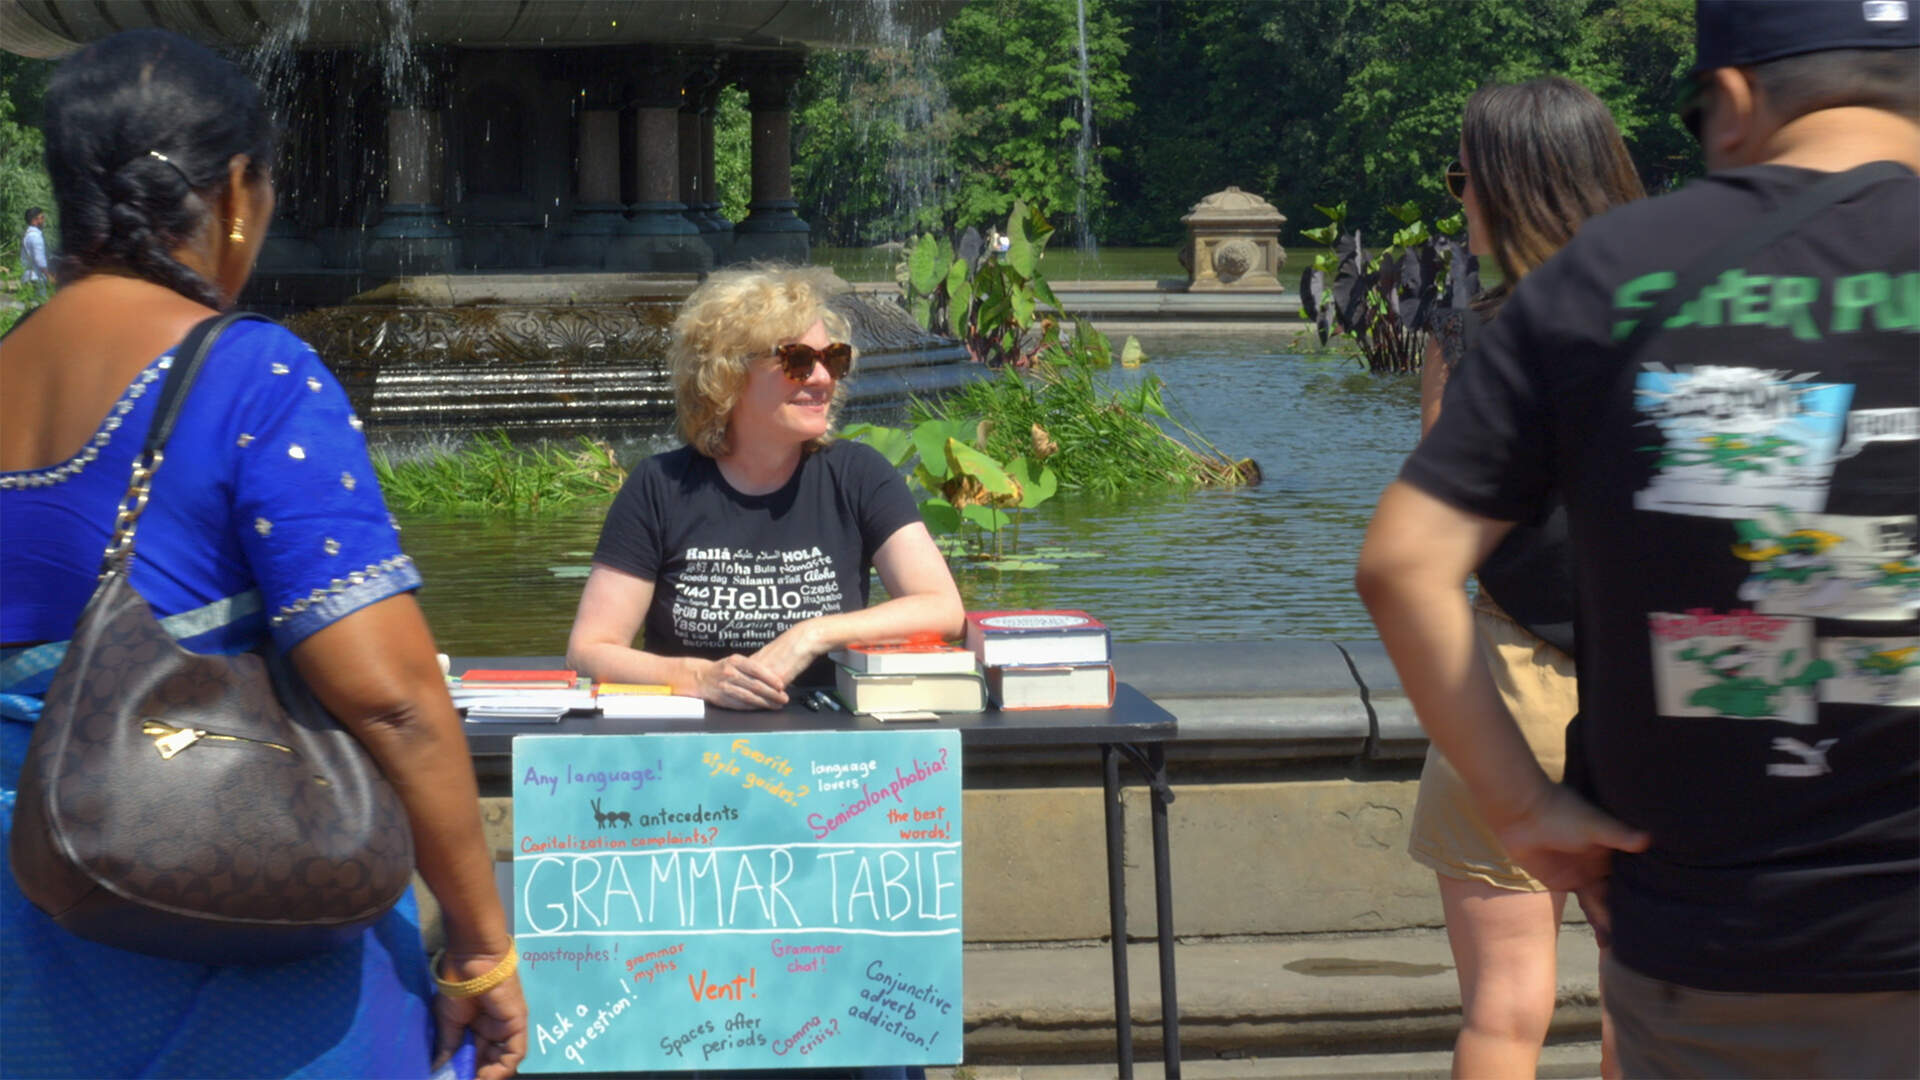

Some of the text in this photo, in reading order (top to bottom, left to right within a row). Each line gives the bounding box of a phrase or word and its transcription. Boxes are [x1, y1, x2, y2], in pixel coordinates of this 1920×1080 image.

[1609, 268, 1823, 341] SPER
[711, 561, 751, 575] Aloha
[754, 564, 776, 574] Bula
[779, 555, 833, 574] Namaste
[781, 546, 822, 563] HOLA
[732, 575, 774, 585] Salaam
[711, 586, 801, 610] Hello
[673, 615, 717, 633] Yasou
[701, 608, 730, 620] Gott
[734, 608, 780, 621] Dobro
[782, 610, 824, 620] Jutro
[731, 739, 792, 777] Favorite
[810, 759, 877, 778] language
[523, 760, 662, 796] Any language!
[702, 751, 810, 807] style guides?
[818, 779, 860, 793] lovers
[807, 748, 949, 840] Semicolonphobia?
[639, 804, 739, 826] antecedents
[886, 806, 945, 824] the best
[899, 817, 951, 840] words!
[521, 827, 718, 854] Capitalization complaints?
[524, 849, 957, 935] GRAMMAR TABLE
[522, 942, 619, 971] apostrophes!
[626, 942, 685, 970] grammar
[771, 939, 842, 958] Grammar
[633, 959, 677, 983] myths
[787, 958, 826, 972] chat!
[689, 968, 757, 1002] Vent!
[866, 961, 952, 1015] Conjunctive
[860, 986, 917, 1021] adverb
[536, 1004, 589, 1054] Ask a
[565, 979, 638, 1065] question!
[660, 1012, 761, 1056] Spaces after
[772, 1015, 821, 1056] Comma
[848, 1003, 939, 1051] addiction!
[702, 1032, 767, 1060] periods
[800, 1019, 840, 1056] crisis?
